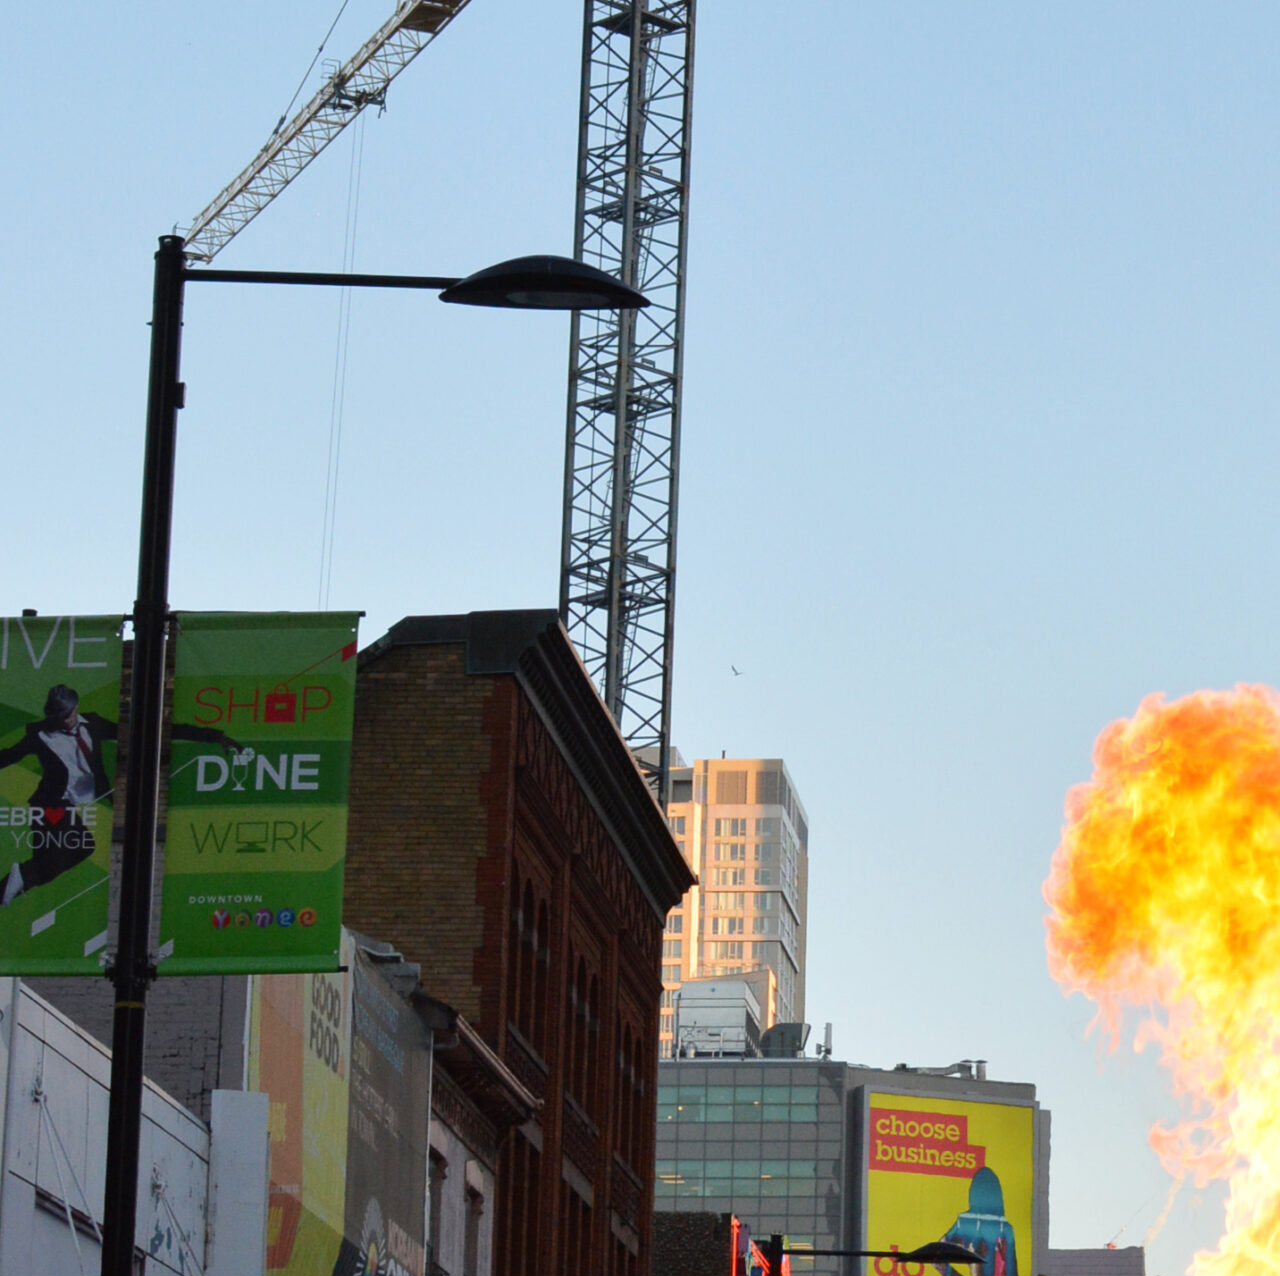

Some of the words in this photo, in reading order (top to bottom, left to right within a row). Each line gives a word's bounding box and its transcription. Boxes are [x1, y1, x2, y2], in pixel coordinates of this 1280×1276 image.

[11, 830, 96, 849] YONGE
[190, 820, 324, 854] WORK
[188, 894, 263, 904] DOWNTOWN
[309, 1010, 339, 1074] FOOD
[875, 1115, 961, 1142] choose
[875, 1139, 977, 1170] business
